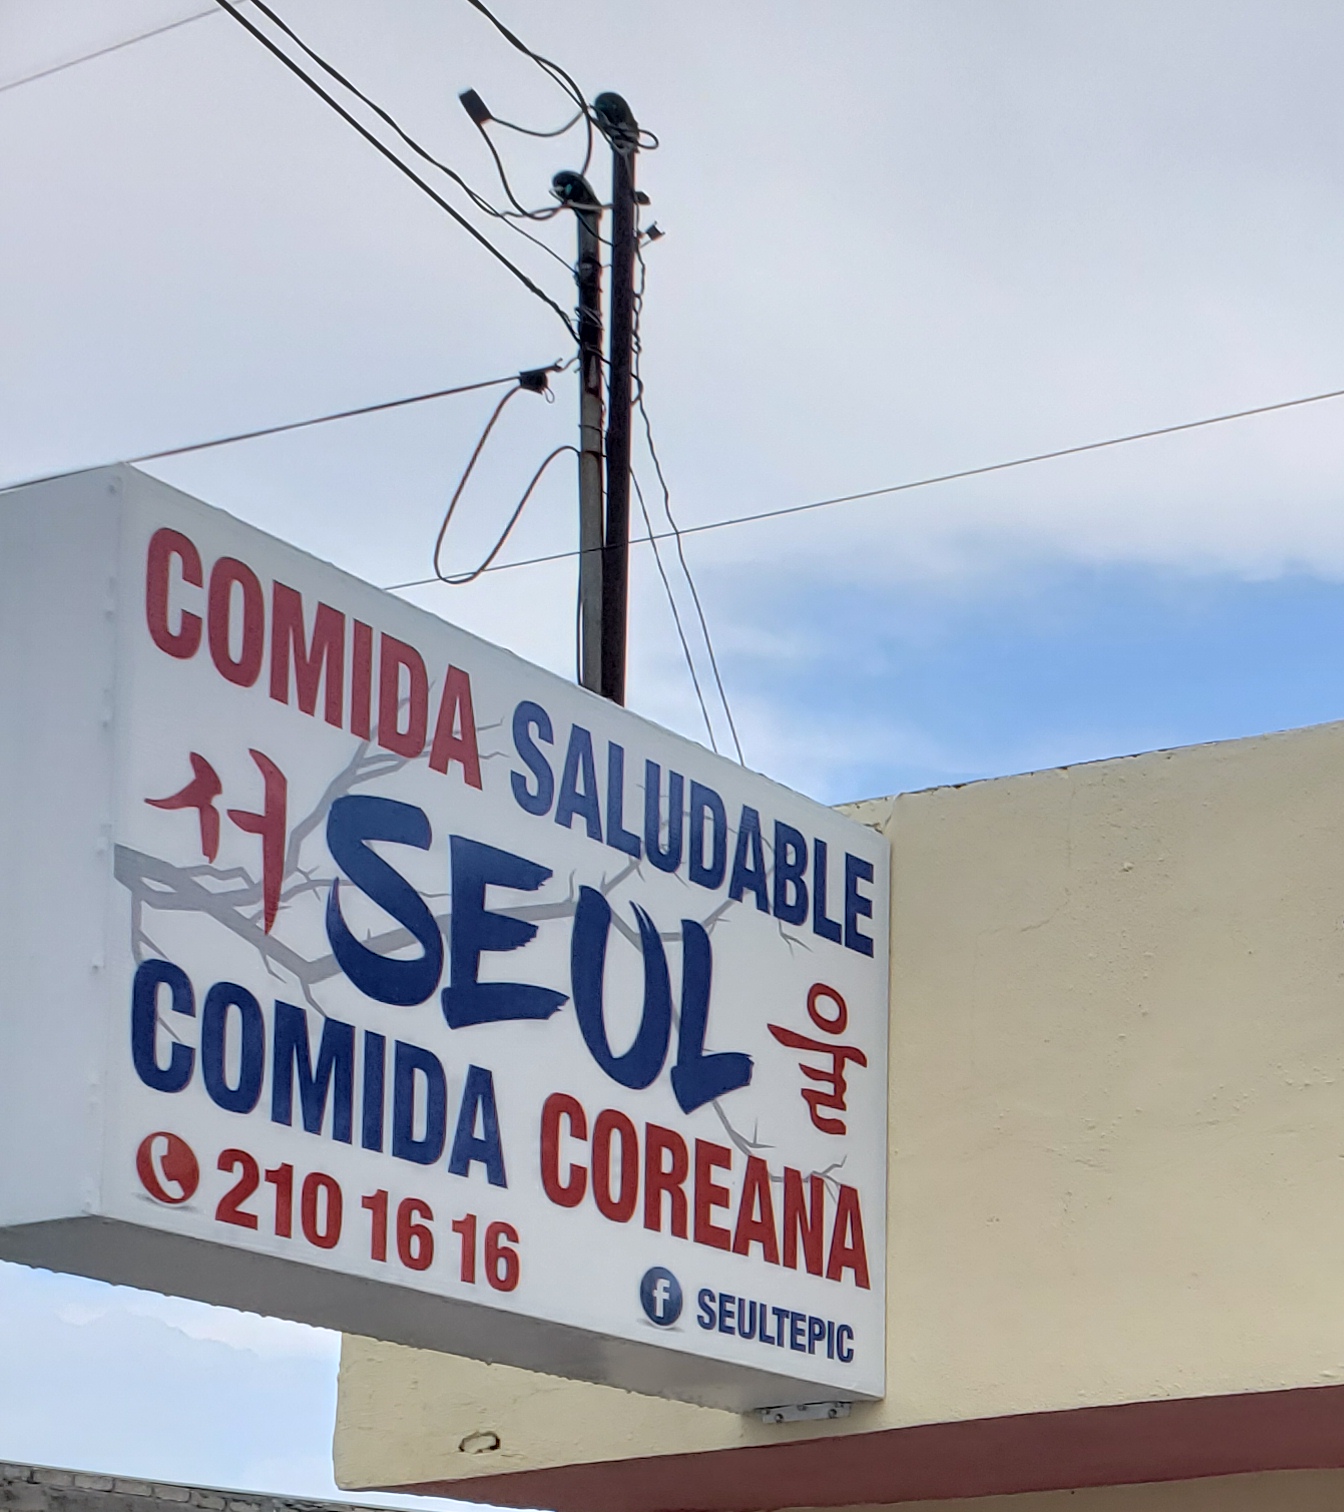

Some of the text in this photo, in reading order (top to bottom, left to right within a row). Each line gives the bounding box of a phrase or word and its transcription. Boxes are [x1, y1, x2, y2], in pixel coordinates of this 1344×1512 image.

[147, 527, 874, 957] COMIDA SALUDABLE
[326, 794, 754, 1114] SEUL
[766, 982, 868, 1136] 울
[131, 959, 870, 1290] COMIDA COREANA
[215, 1148, 520, 1292] 210 16 16
[697, 1288, 855, 1363] SEULTEPIC
